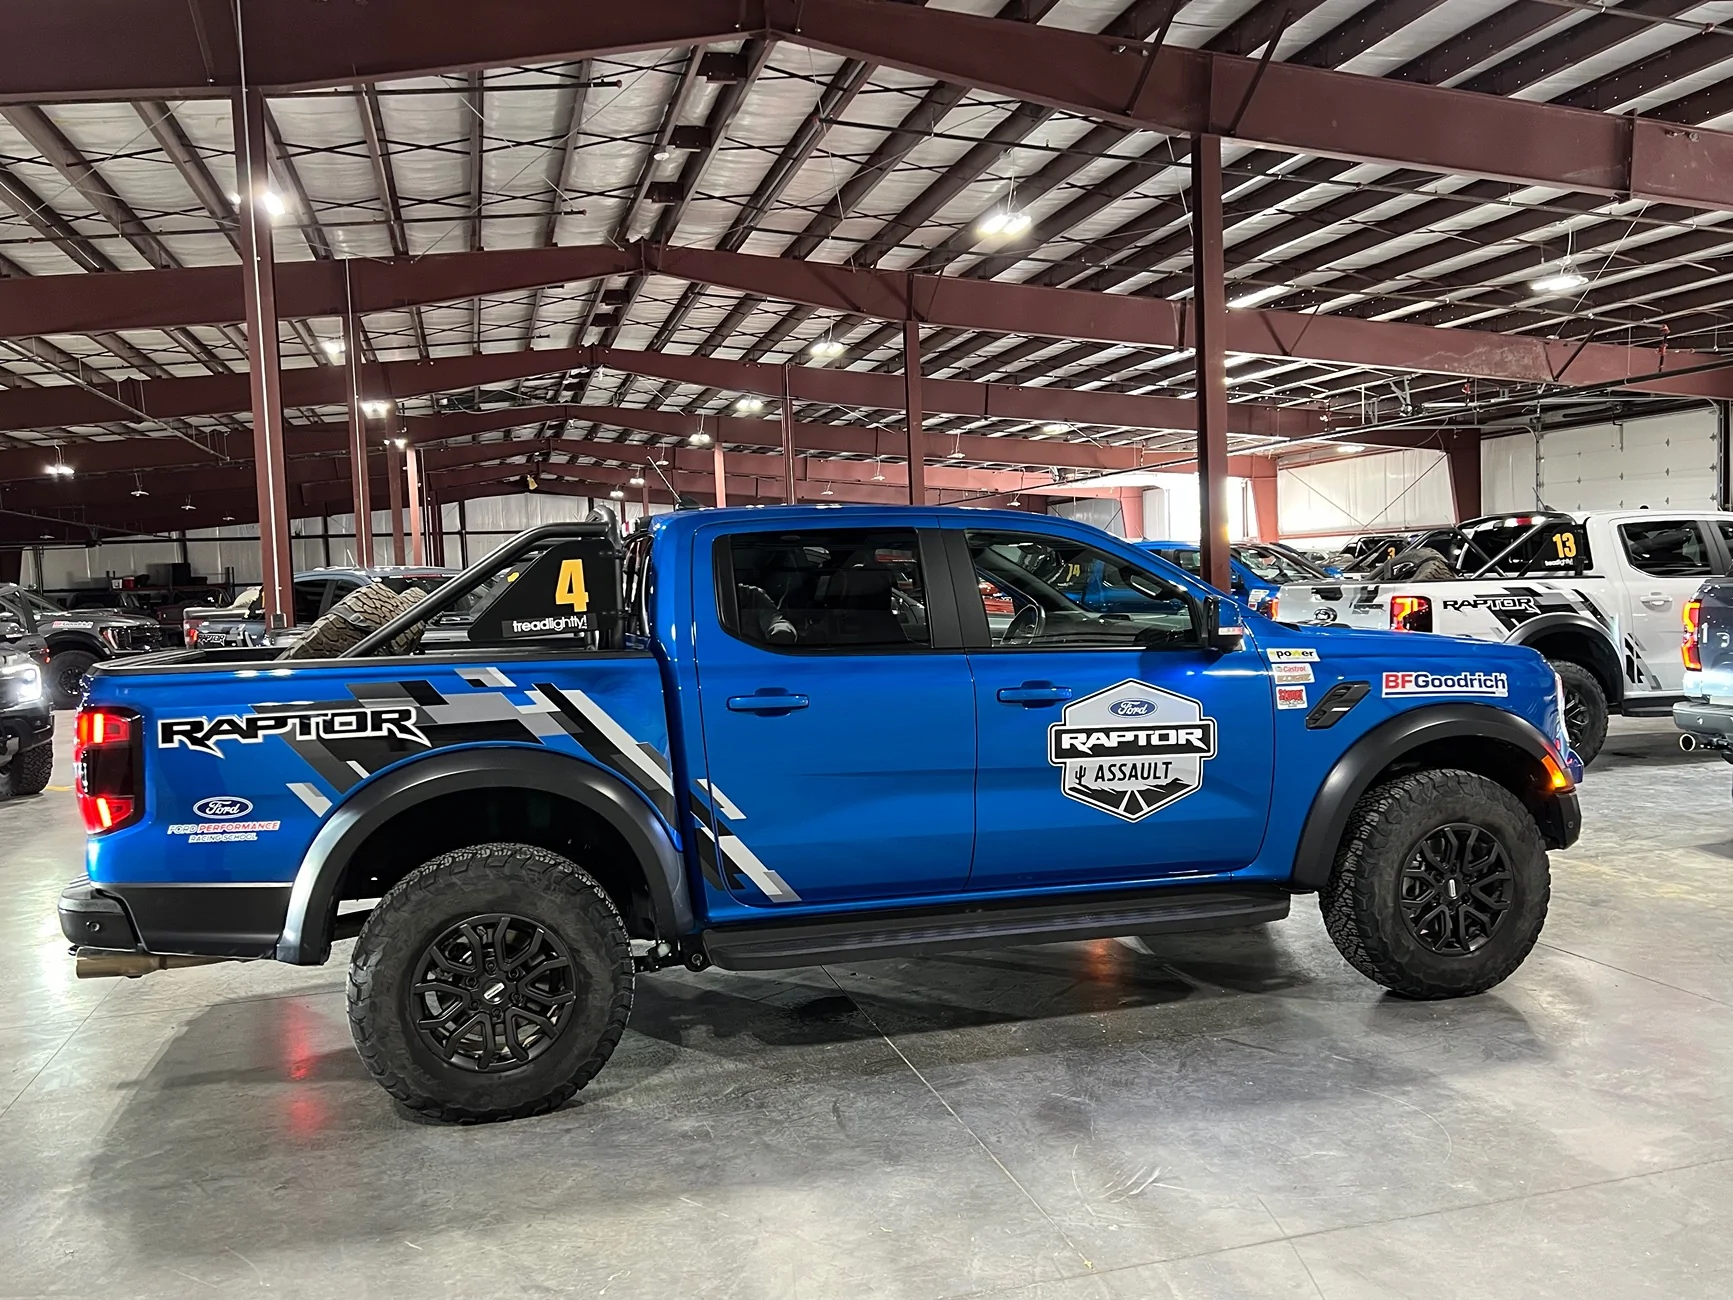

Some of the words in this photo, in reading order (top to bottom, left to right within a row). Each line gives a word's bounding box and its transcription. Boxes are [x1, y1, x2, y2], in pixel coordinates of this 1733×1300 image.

[1552, 532, 1577, 558] 13
[555, 559, 589, 612] 4
[1443, 596, 1541, 616] RAPTOR
[513, 614, 588, 632] treadlightly!
[1385, 673, 1506, 689] BFGoodrich
[1118, 701, 1148, 715] Ford
[158, 706, 432, 759] RAPTOR
[1061, 728, 1208, 755] RAPTOR
[1094, 761, 1173, 783] ASSAULT
[205, 800, 241, 815] Ford
[168, 824, 197, 834] FORD
[198, 821, 280, 833] PERFORMANCE
[189, 834, 220, 843] RACING
[222, 833, 258, 841] SCHOOL
